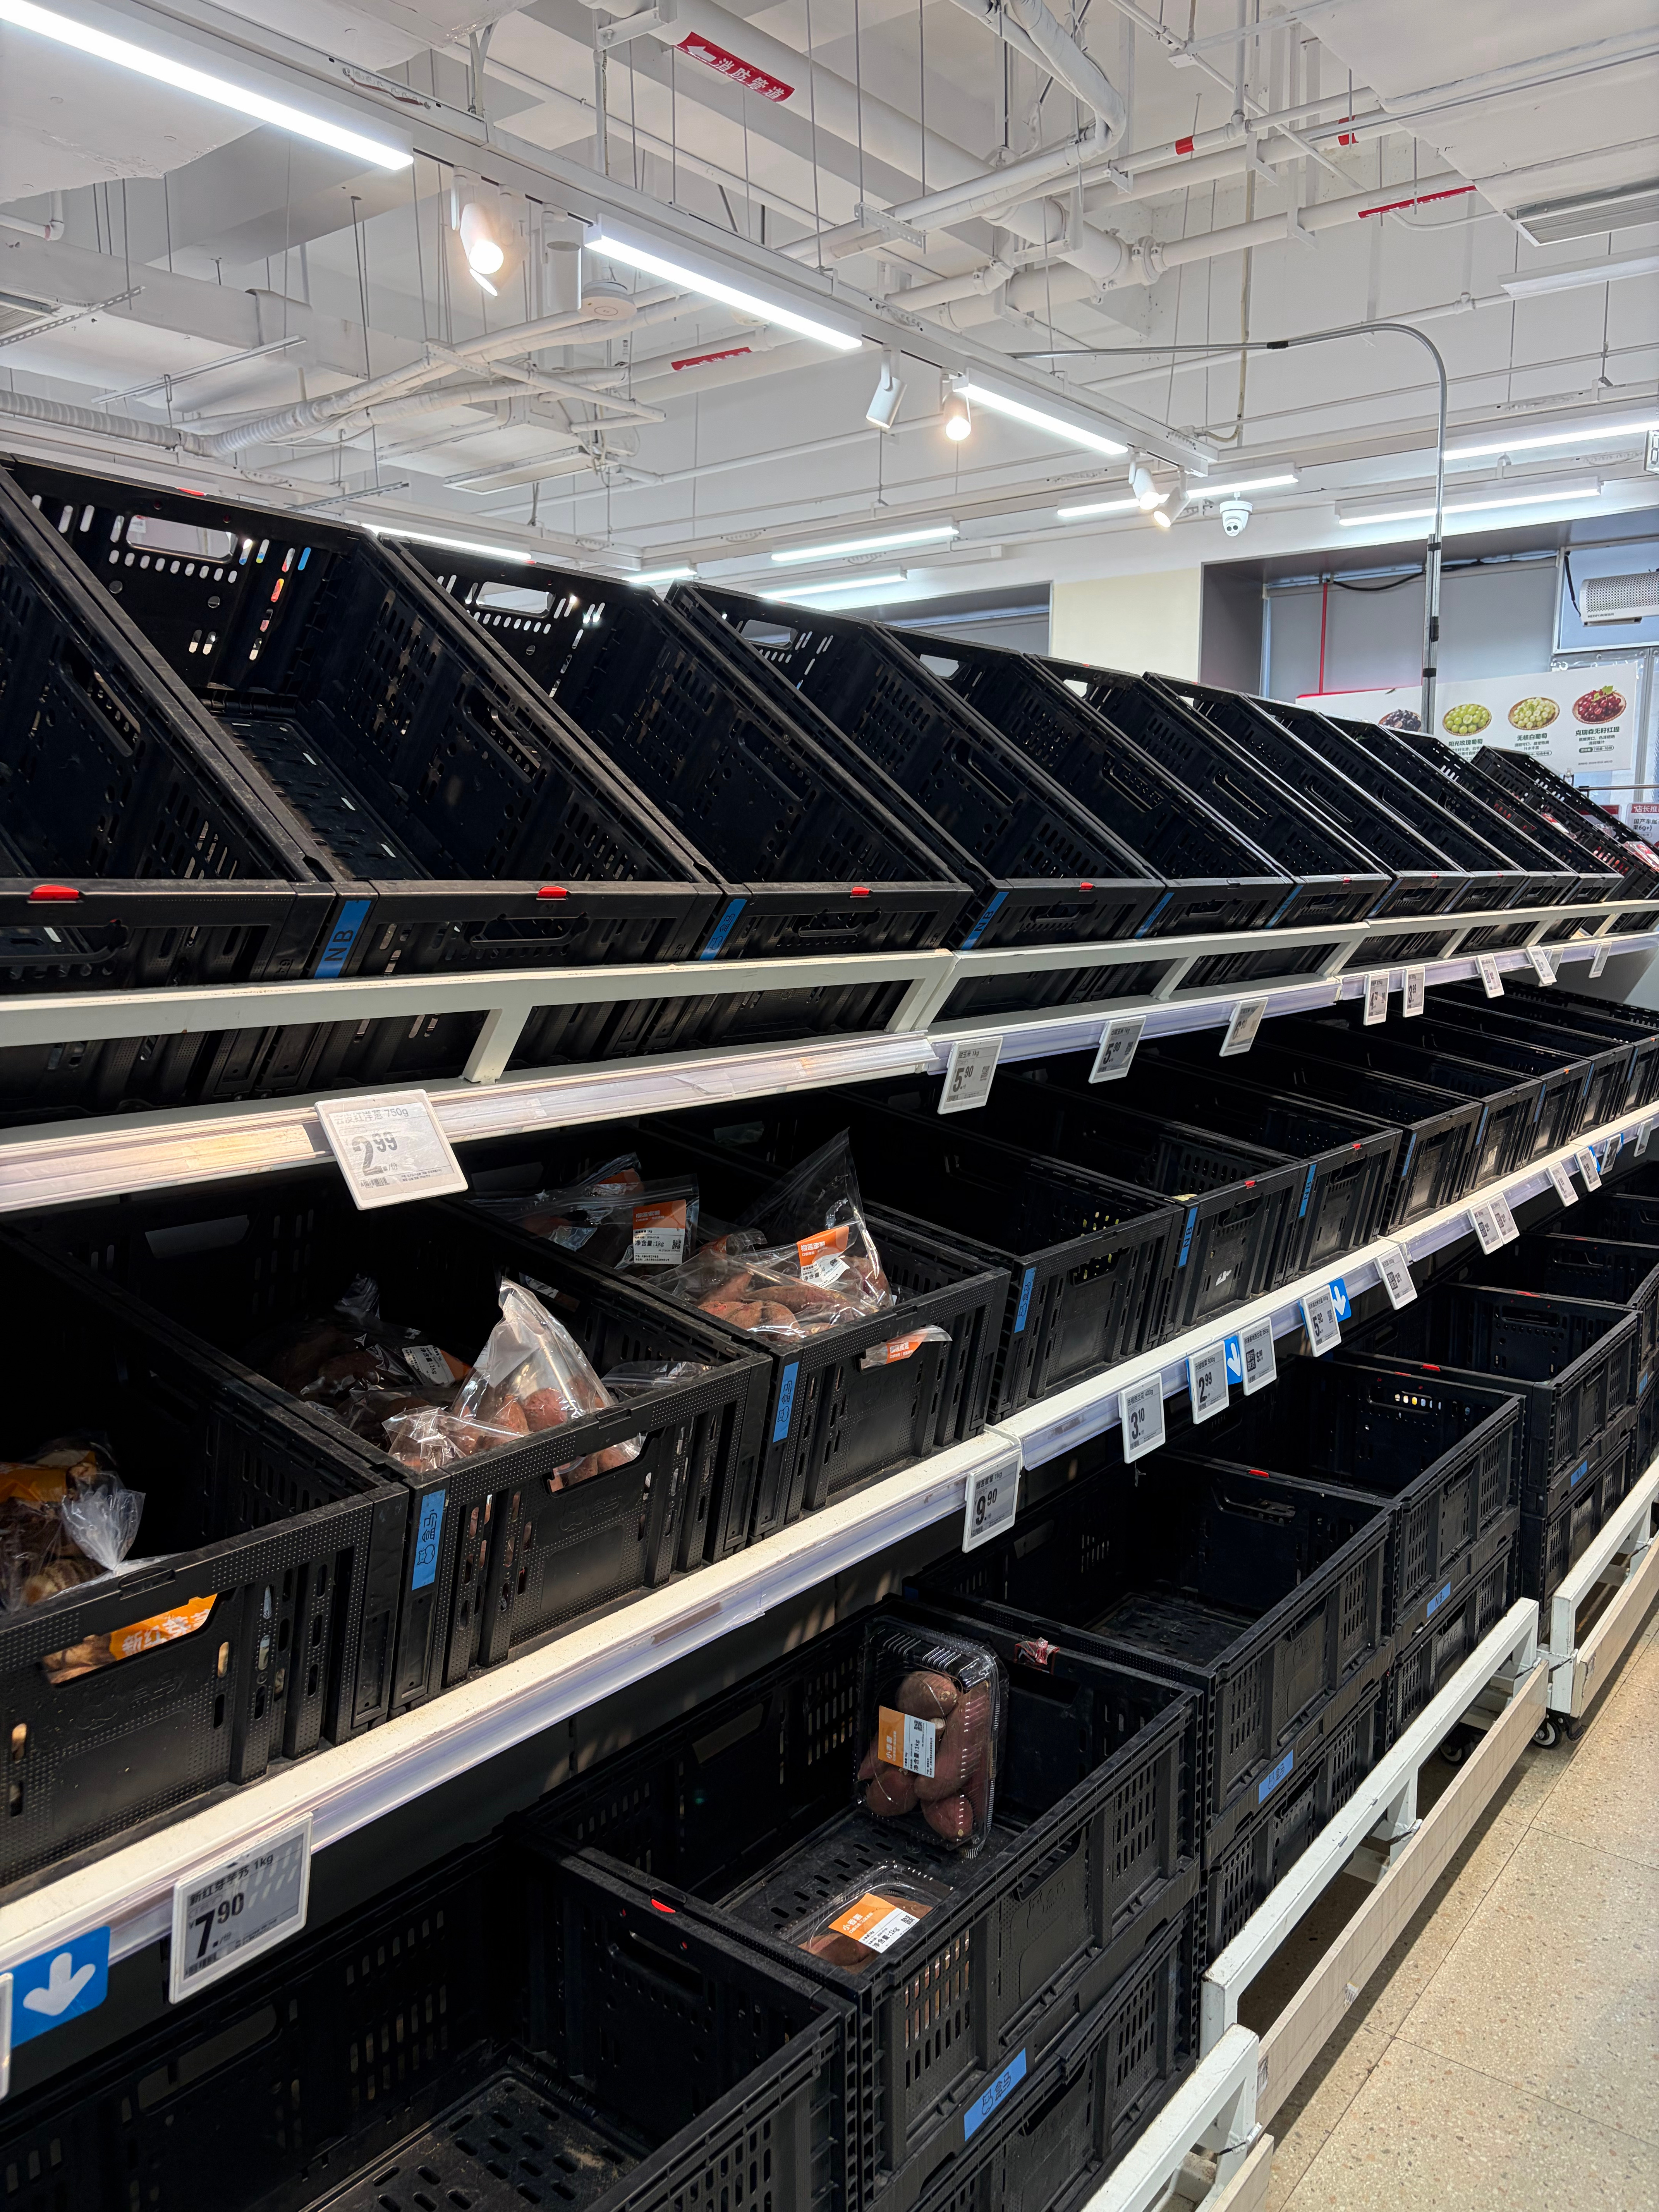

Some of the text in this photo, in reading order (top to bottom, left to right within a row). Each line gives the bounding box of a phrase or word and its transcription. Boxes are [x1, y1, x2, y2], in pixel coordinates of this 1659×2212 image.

[716, 58, 785, 99] 消防管道
[1517, 733, 1547, 741] 无核白葡萄
[974, 910, 994, 932] NB
[324, 930, 353, 962] NB
[387, 1108, 409, 1118] 750g
[1183, 1226, 1192, 1248] NB
[422, 1510, 438, 1542] 盒马
[254, 1854, 273, 1870] 1kg
[995, 2071, 1011, 2102] 盒马
